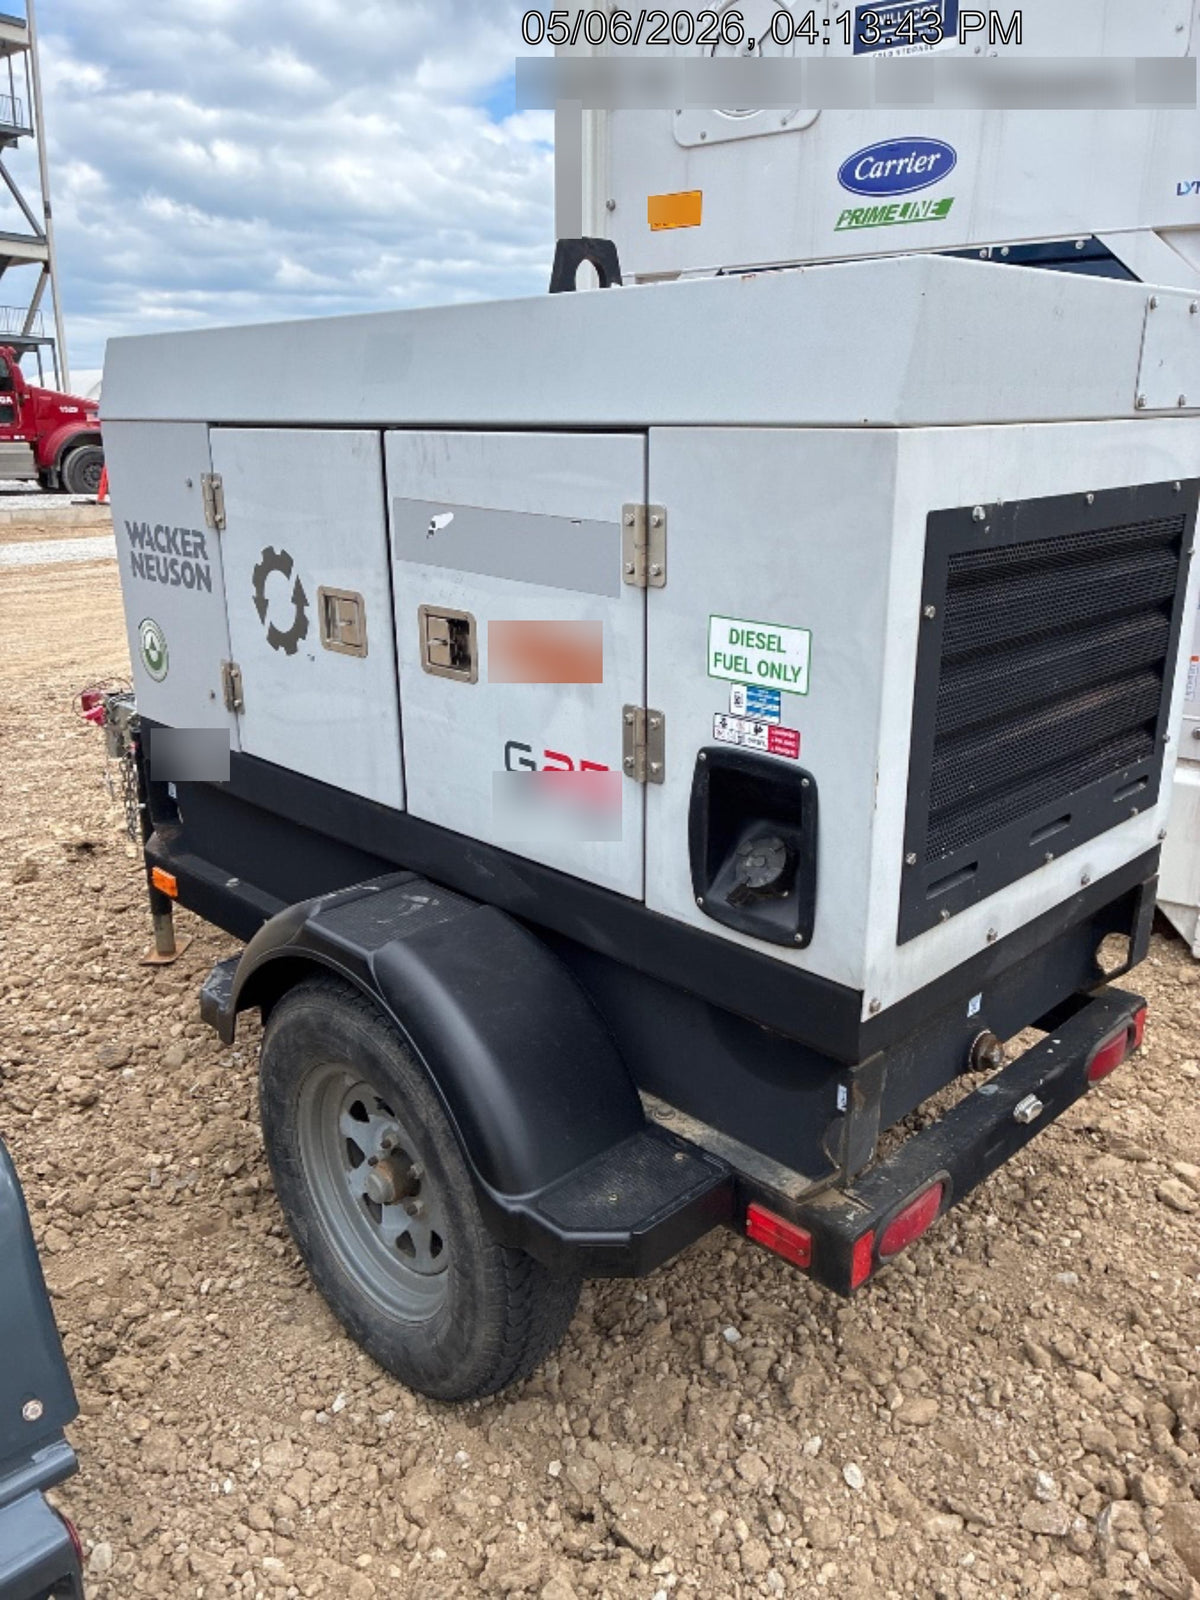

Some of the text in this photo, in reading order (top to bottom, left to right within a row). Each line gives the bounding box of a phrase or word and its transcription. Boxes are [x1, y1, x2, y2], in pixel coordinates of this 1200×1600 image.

[854, 152, 941, 180] Carrier
[836, 198, 953, 226] PRIMELINE
[124, 520, 209, 560] WACKER
[130, 550, 213, 593] NEUSON
[728, 627, 786, 654] DIESEL
[714, 652, 802, 683] FUEL ONLY
